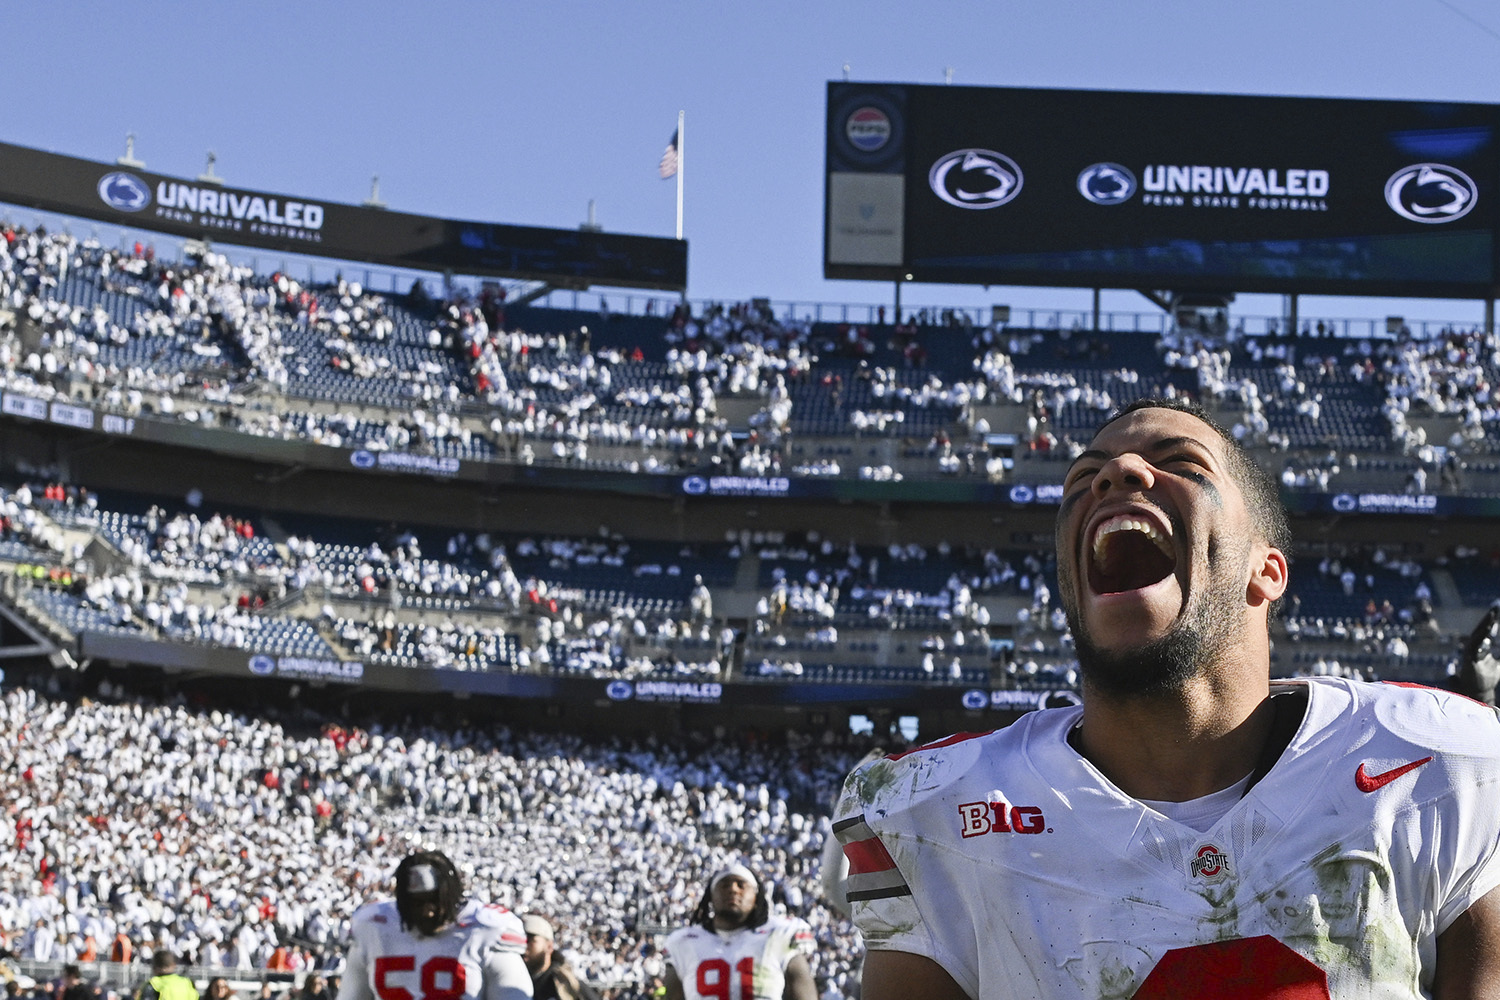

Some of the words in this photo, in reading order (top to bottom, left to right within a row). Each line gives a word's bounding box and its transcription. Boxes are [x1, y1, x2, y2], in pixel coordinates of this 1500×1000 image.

[1143, 164, 1329, 197] UNRIVALED
[156, 181, 324, 230] UNRIVALED
[1142, 193, 1185, 207] PENN
[1192, 195, 1240, 209] STATE
[1248, 197, 1329, 211] FOOTBALL
[378, 451, 460, 473] UNRIVALED
[709, 476, 790, 492] UNRIVALED
[1359, 494, 1438, 509] UNRIVALED
[277, 657, 365, 679] UNRIVALED
[635, 681, 723, 699] UNRIVALED
